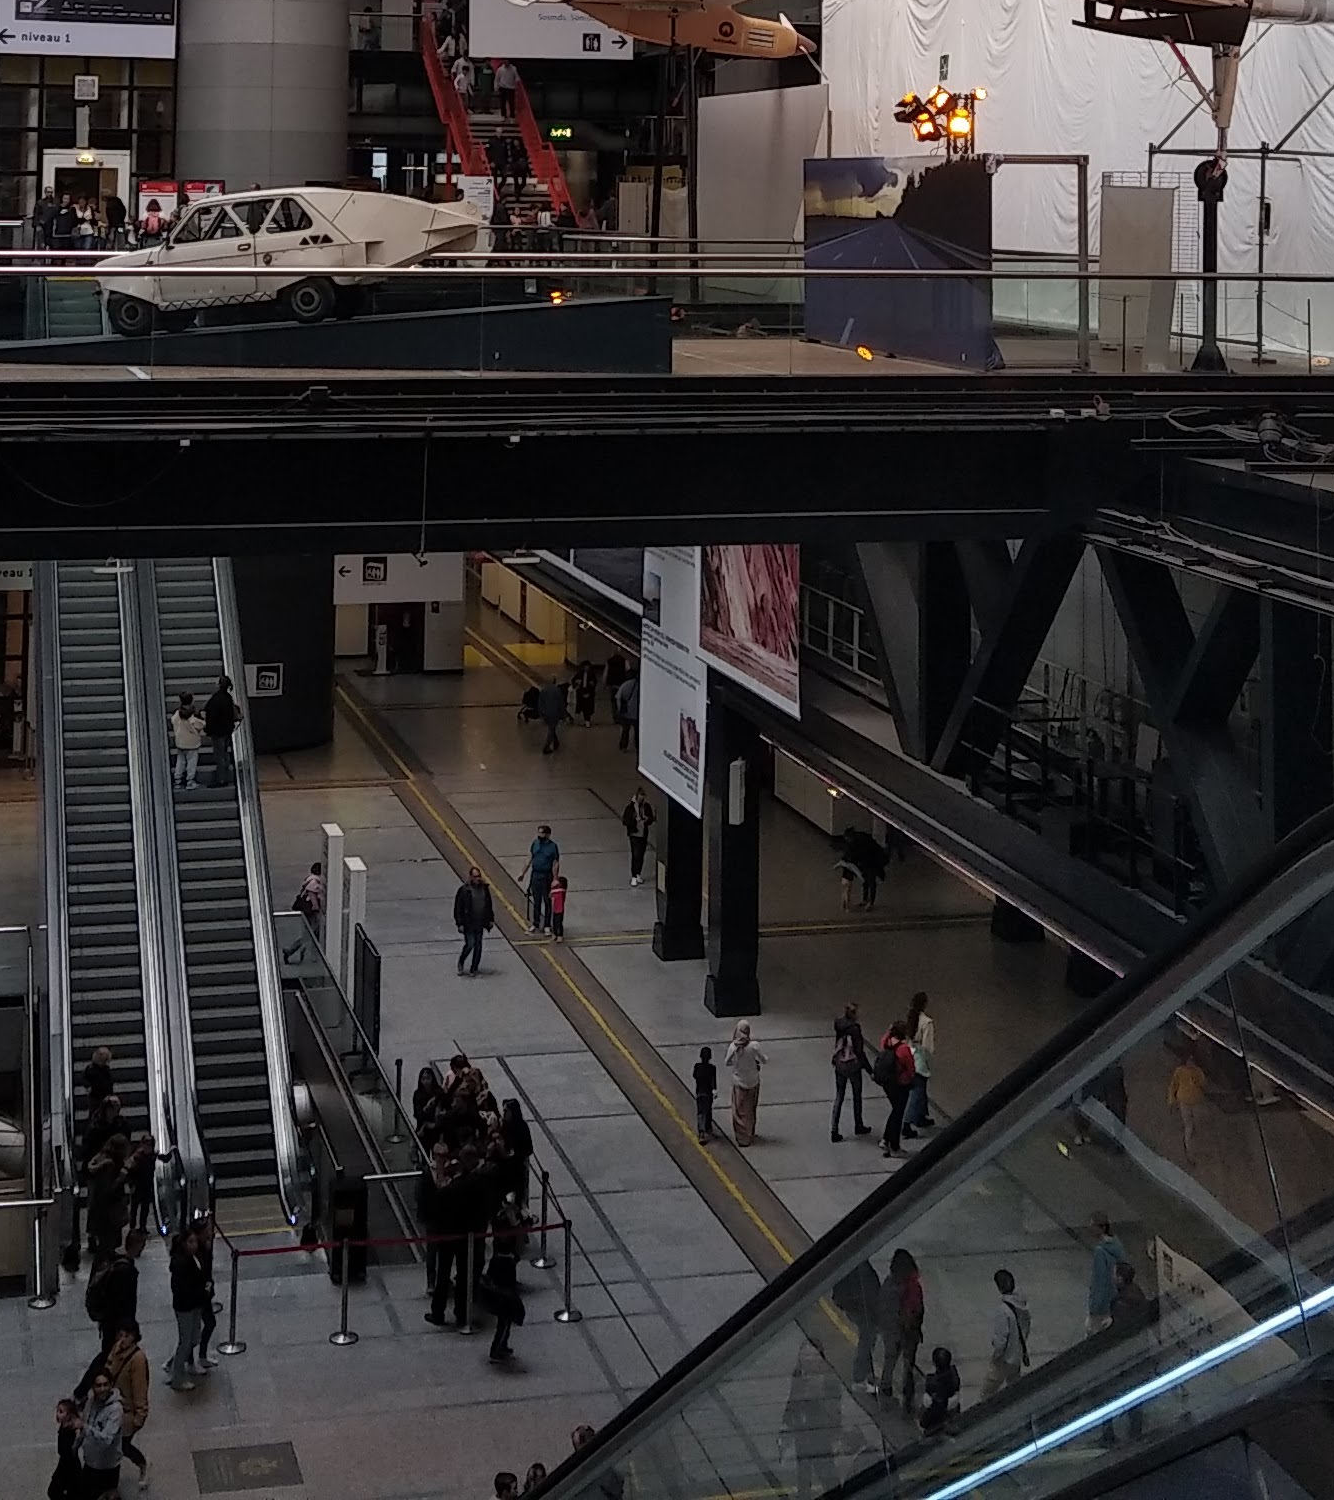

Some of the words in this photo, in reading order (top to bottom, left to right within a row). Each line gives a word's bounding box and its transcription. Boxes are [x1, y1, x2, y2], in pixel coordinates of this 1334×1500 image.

[21, 32, 61, 43] niveau
[65, 34, 71, 43] 1
[28, 568, 33, 577] 1
